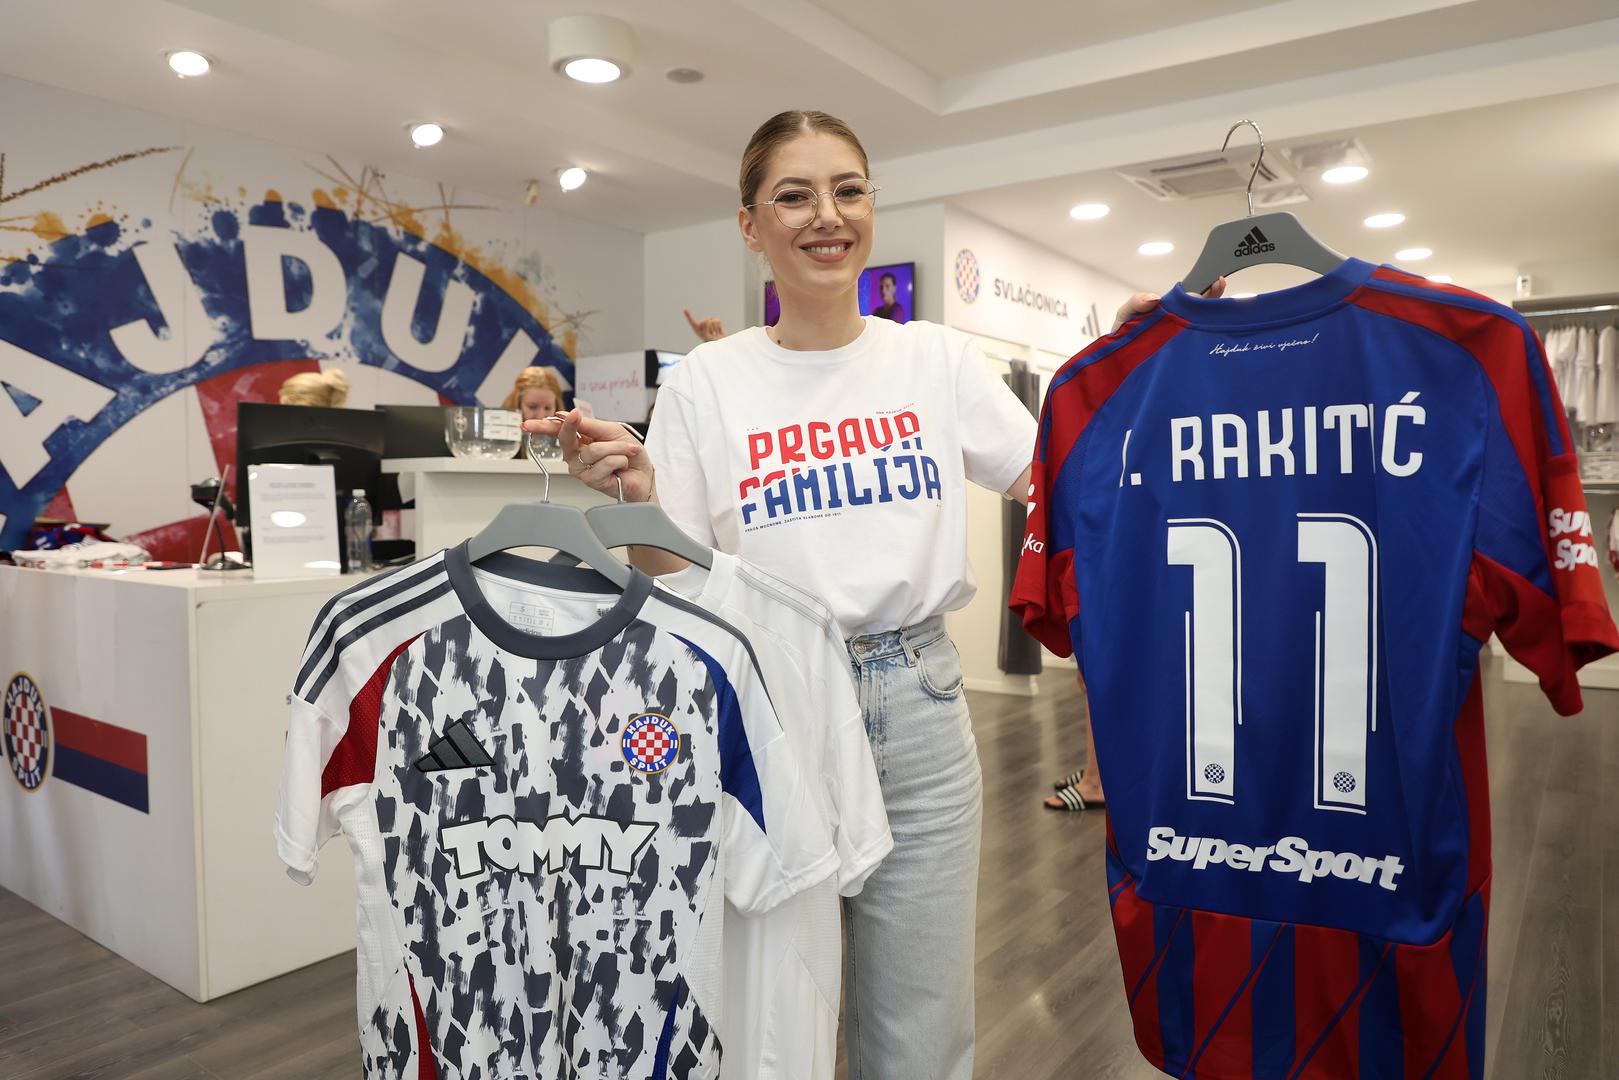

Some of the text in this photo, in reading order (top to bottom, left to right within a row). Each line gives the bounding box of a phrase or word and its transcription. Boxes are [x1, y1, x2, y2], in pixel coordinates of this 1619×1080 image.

[1234, 243, 1275, 257] adidas
[1209, 343, 1250, 357] Hajduk
[1170, 391, 1427, 482] RAKITĆ
[739, 454, 943, 526] FAMILIJA
[1166, 512, 1379, 816] 11
[6, 676, 43, 716] HAJDUK
[626, 716, 675, 736] HAJDUK
[12, 756, 41, 788] SPLIT
[630, 757, 667, 772] SPLIT
[439, 813, 660, 879] TOMMY
[1146, 826, 1405, 892] SuperSport
